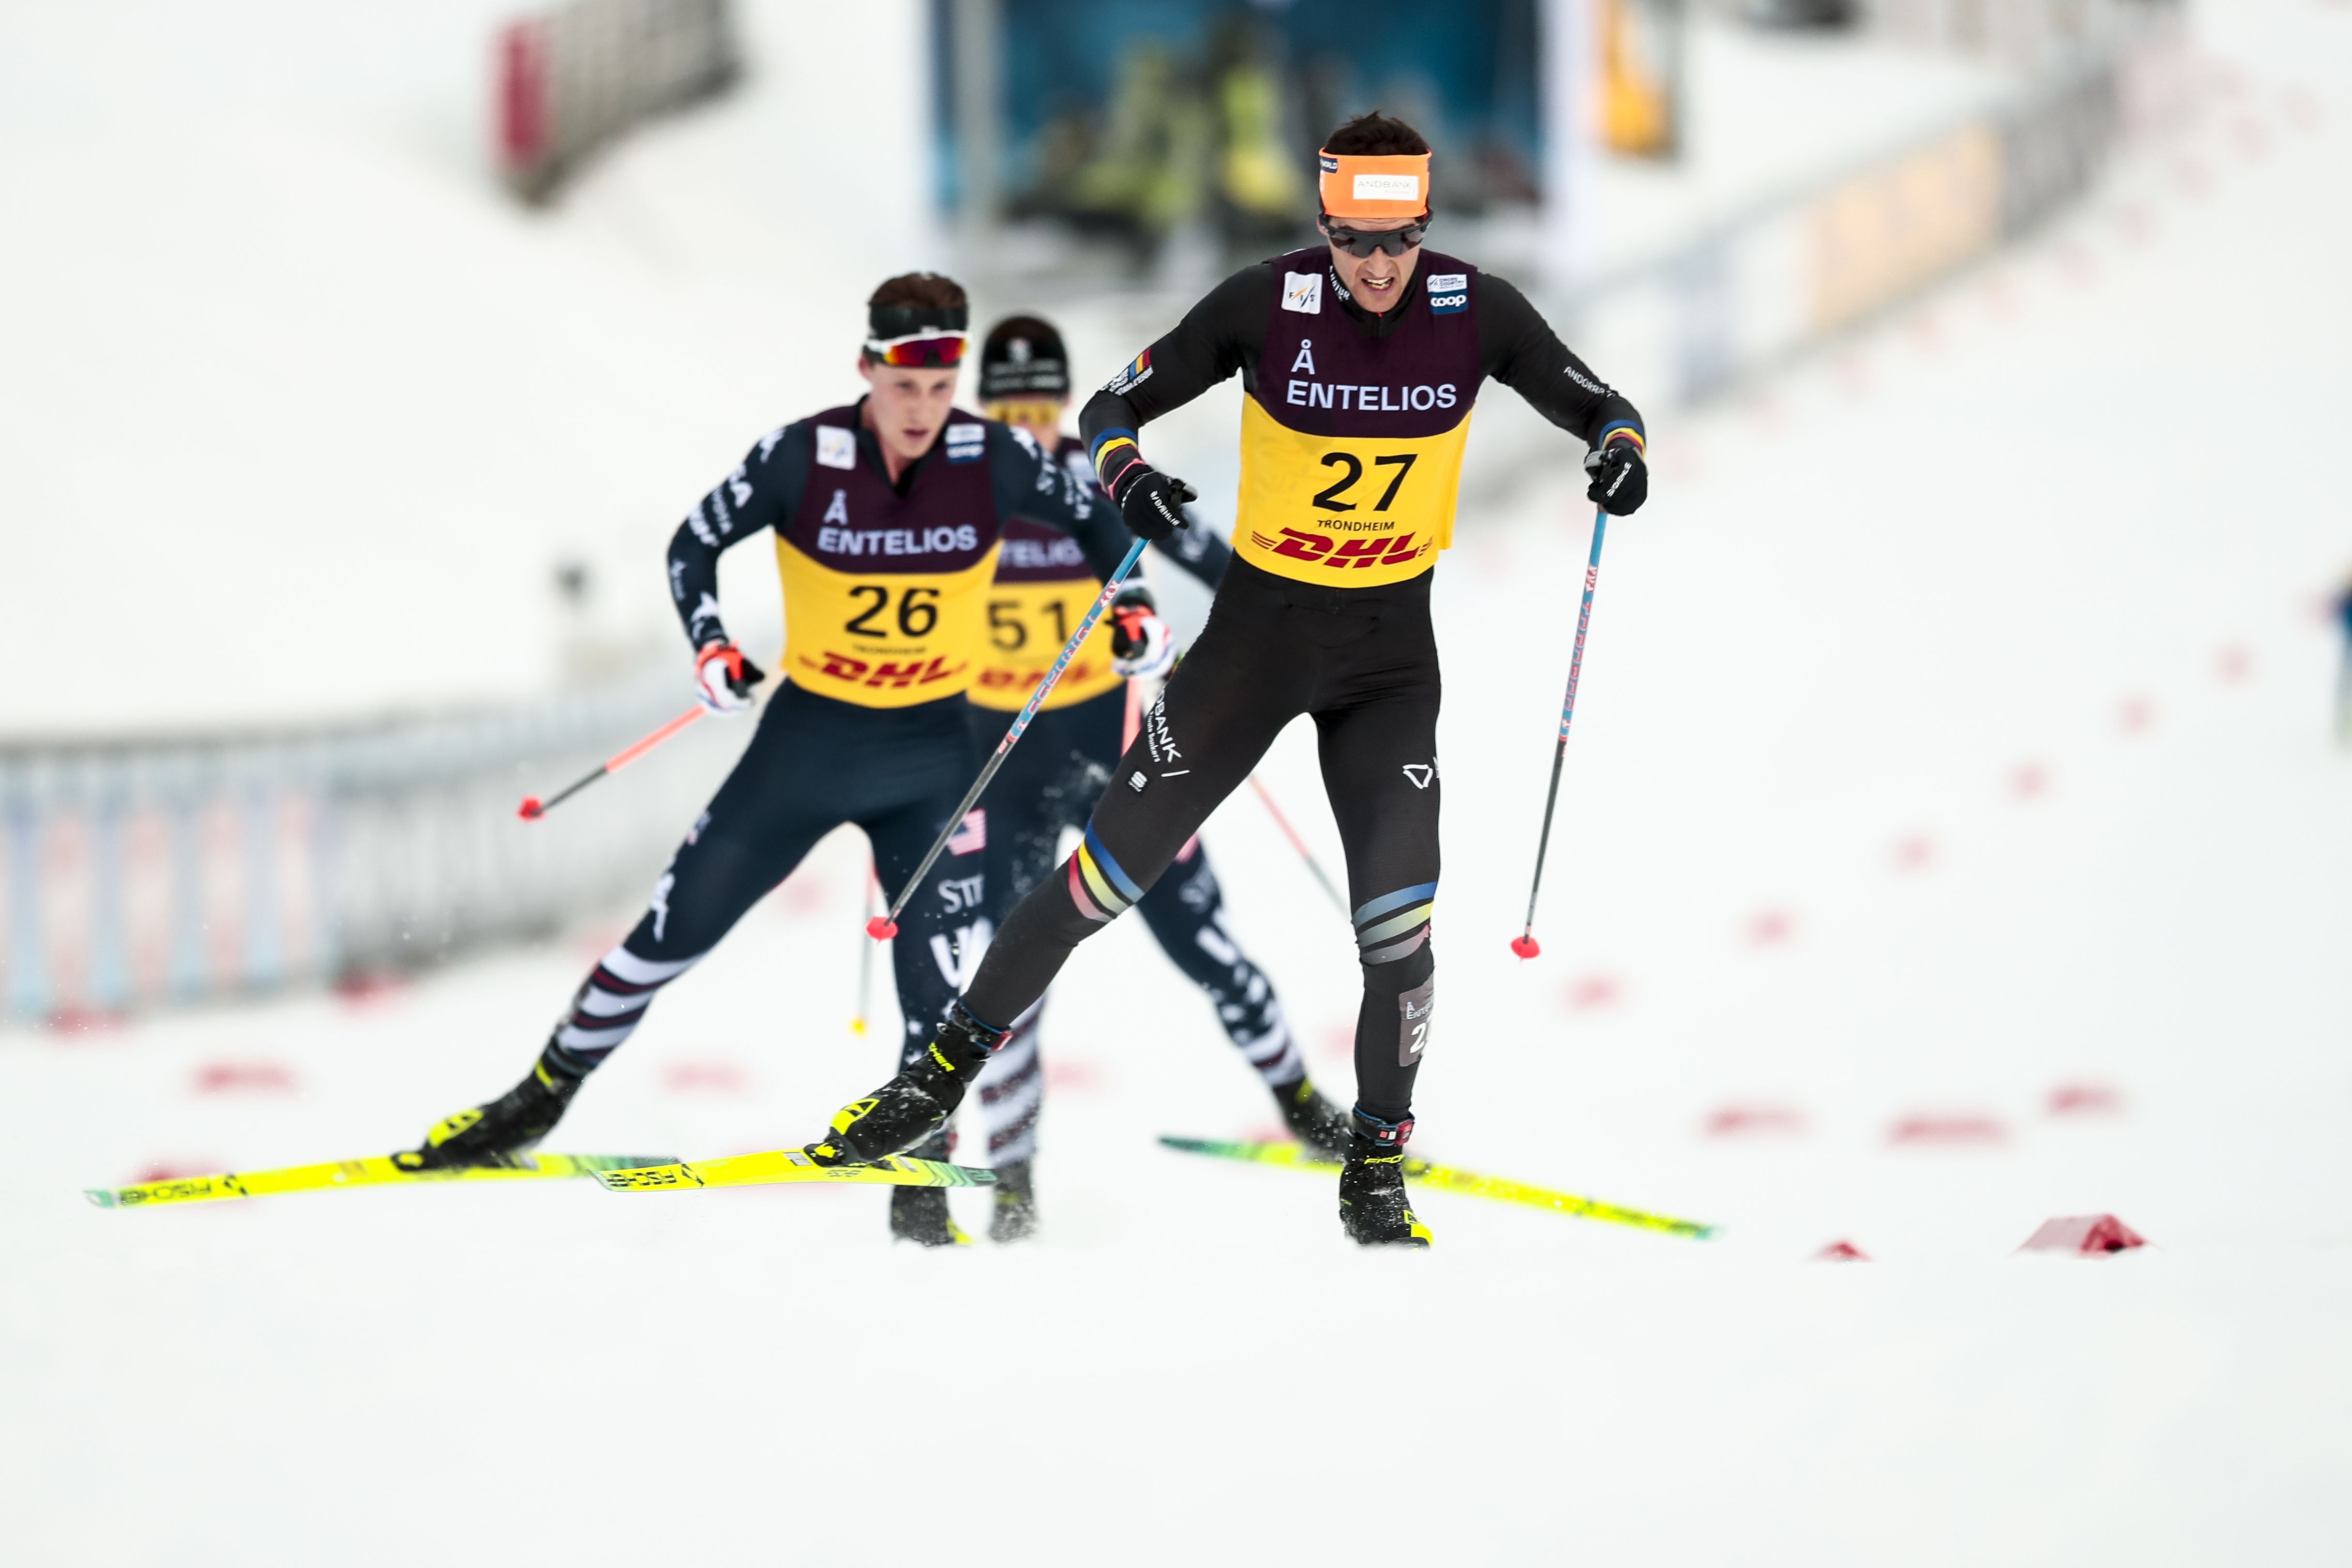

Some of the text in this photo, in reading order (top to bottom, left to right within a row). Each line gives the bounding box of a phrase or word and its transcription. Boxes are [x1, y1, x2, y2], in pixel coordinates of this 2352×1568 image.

[1431, 294, 1467, 307] coop
[1291, 339, 1315, 375] Å
[1286, 379, 1457, 411] ENTELIOS
[1312, 452, 1419, 512] 27
[824, 488, 848, 525] Å
[817, 524, 979, 556] ENTELIOS
[1317, 519, 1395, 532] TRONDHEIM
[1271, 527, 1420, 569] DHL
[845, 586, 940, 638] 26
[987, 599, 1068, 652] 51
[822, 650, 948, 688] DHL
